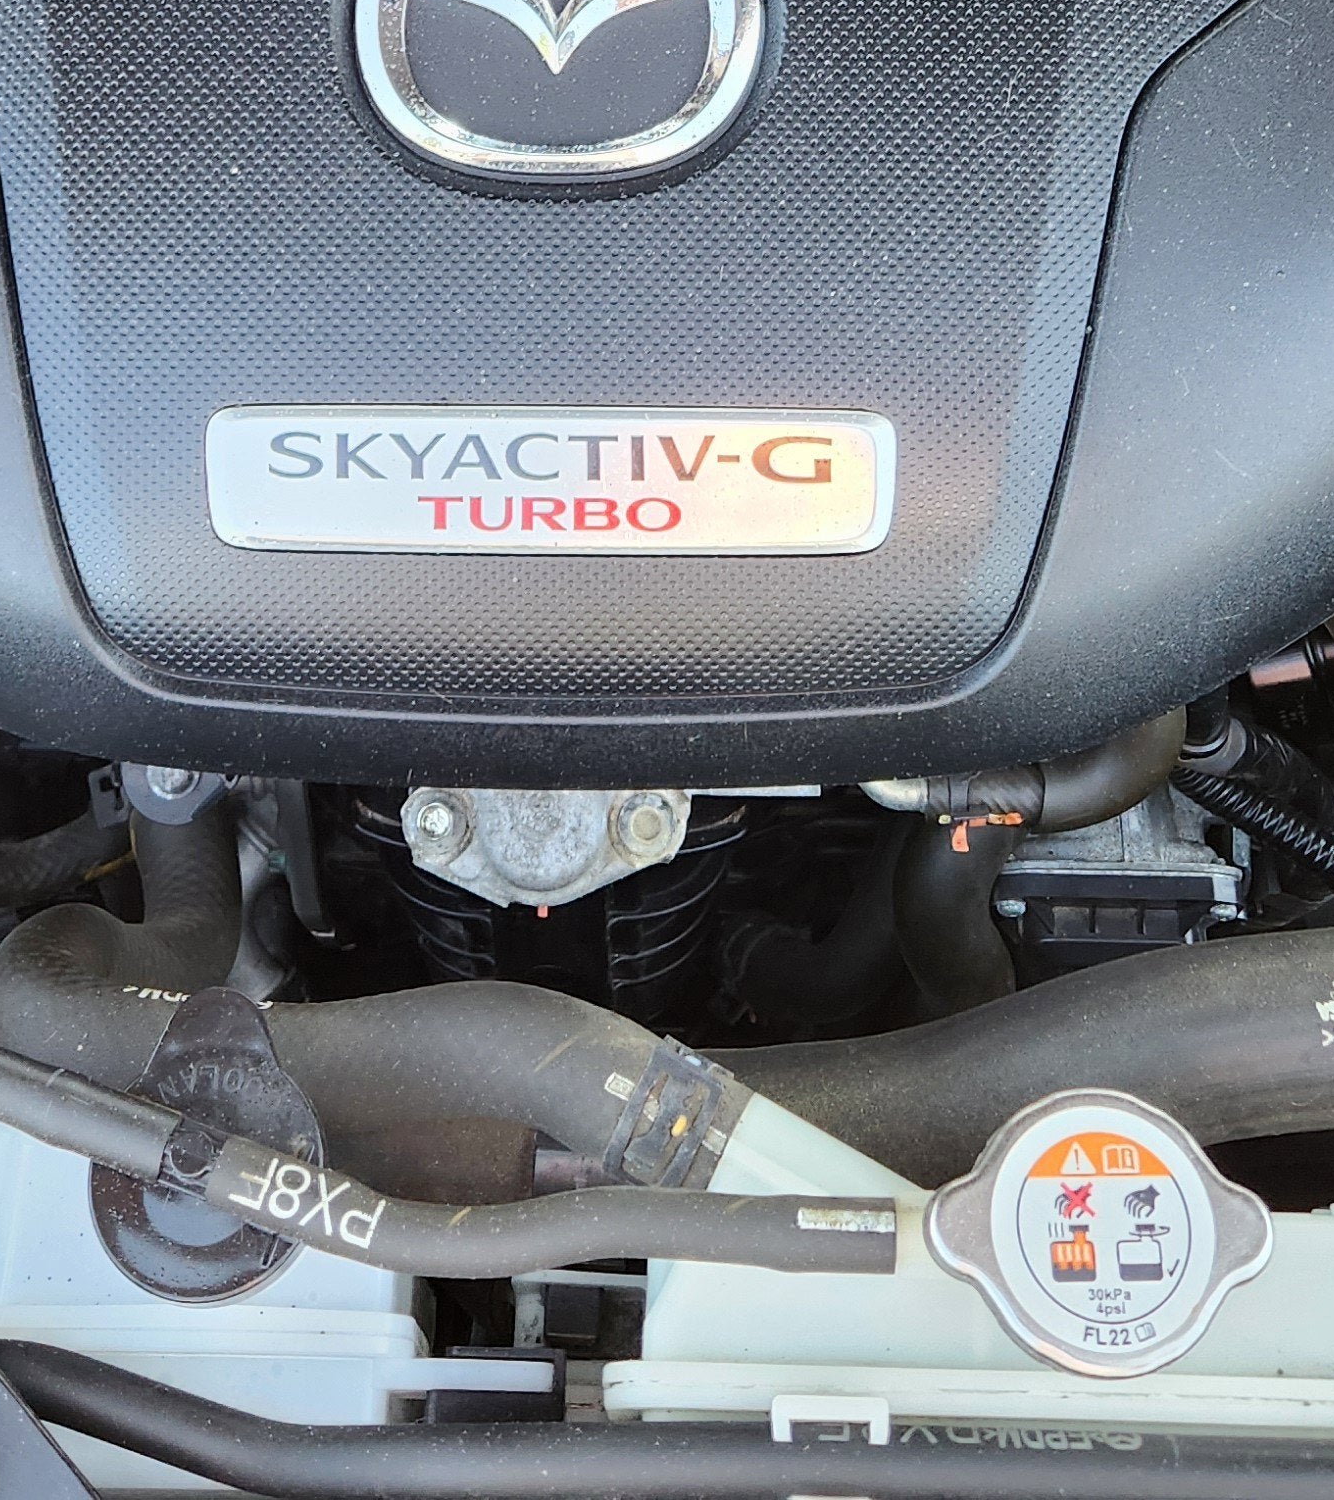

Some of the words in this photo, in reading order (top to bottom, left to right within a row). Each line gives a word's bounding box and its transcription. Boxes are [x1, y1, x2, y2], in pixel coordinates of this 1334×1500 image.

[267, 431, 833, 485] SKYACTIV-G
[416, 495, 684, 533] TURBO
[227, 1158, 386, 1248] PX8F
[1088, 1288, 1131, 1300] 30kPa
[1096, 1302, 1125, 1316] 4psi
[1083, 1326, 1131, 1345] FL22
